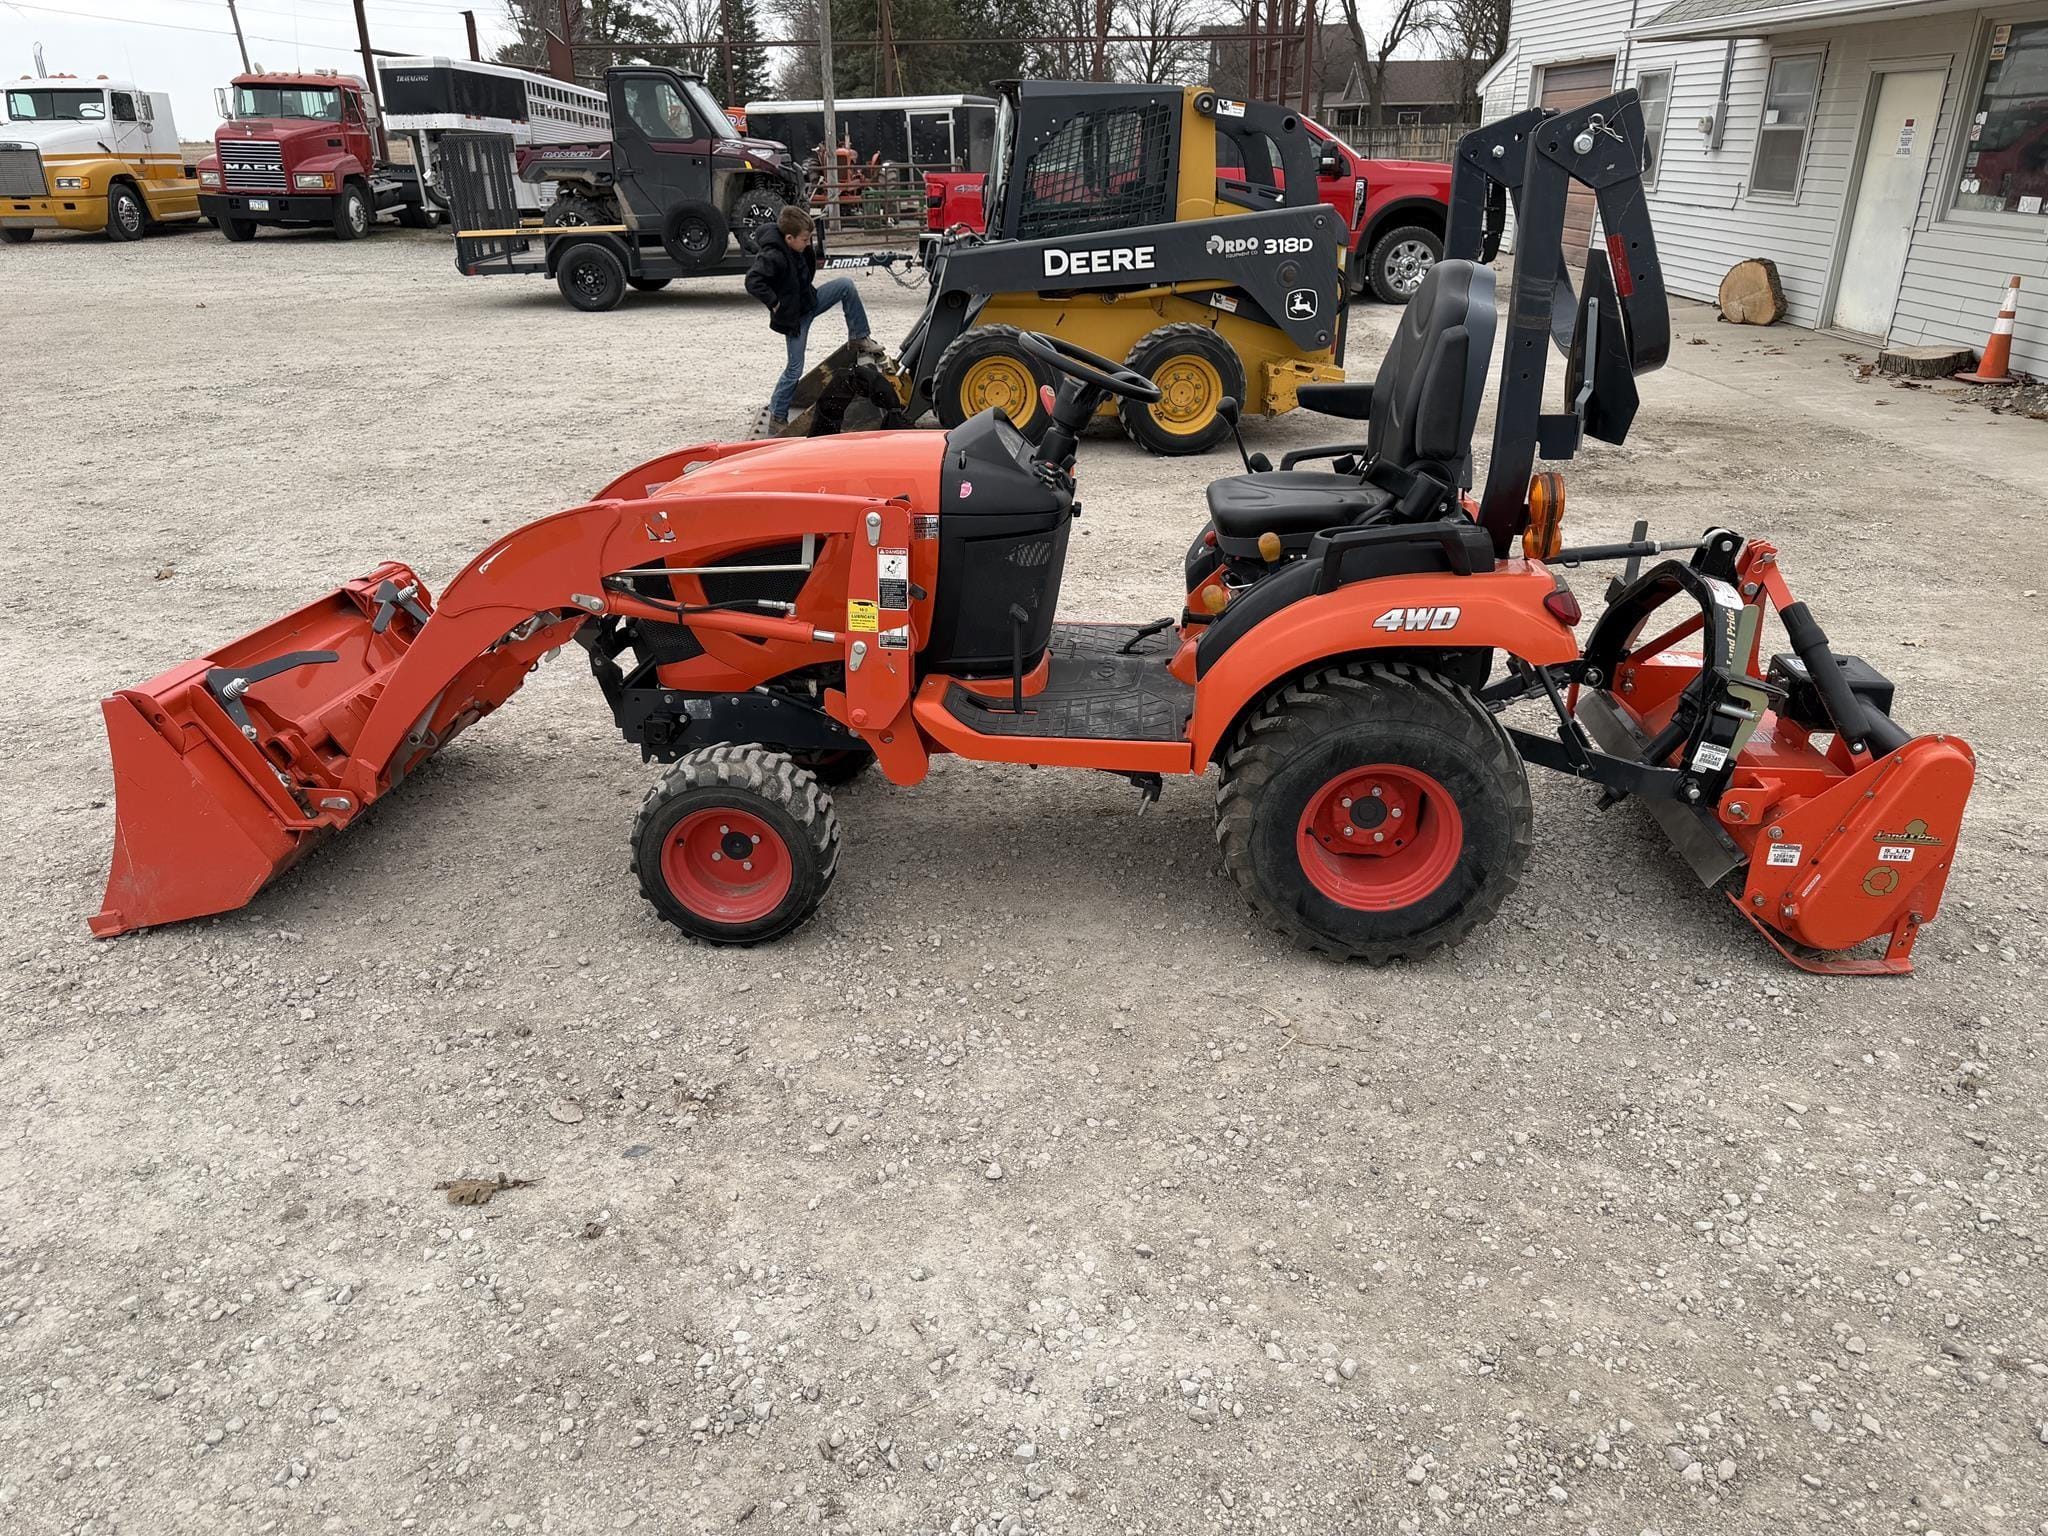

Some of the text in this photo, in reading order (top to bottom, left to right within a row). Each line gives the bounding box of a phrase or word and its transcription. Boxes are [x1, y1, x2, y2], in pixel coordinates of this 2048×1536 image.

[542, 151, 593, 159] RANGER
[225, 163, 281, 171] MACK
[1264, 237, 1314, 254] 318D
[823, 257, 870, 269] LAMAR
[1043, 246, 1155, 277] DEERE
[1372, 606, 1461, 632] 4WD
[1726, 606, 1736, 637] Pride
